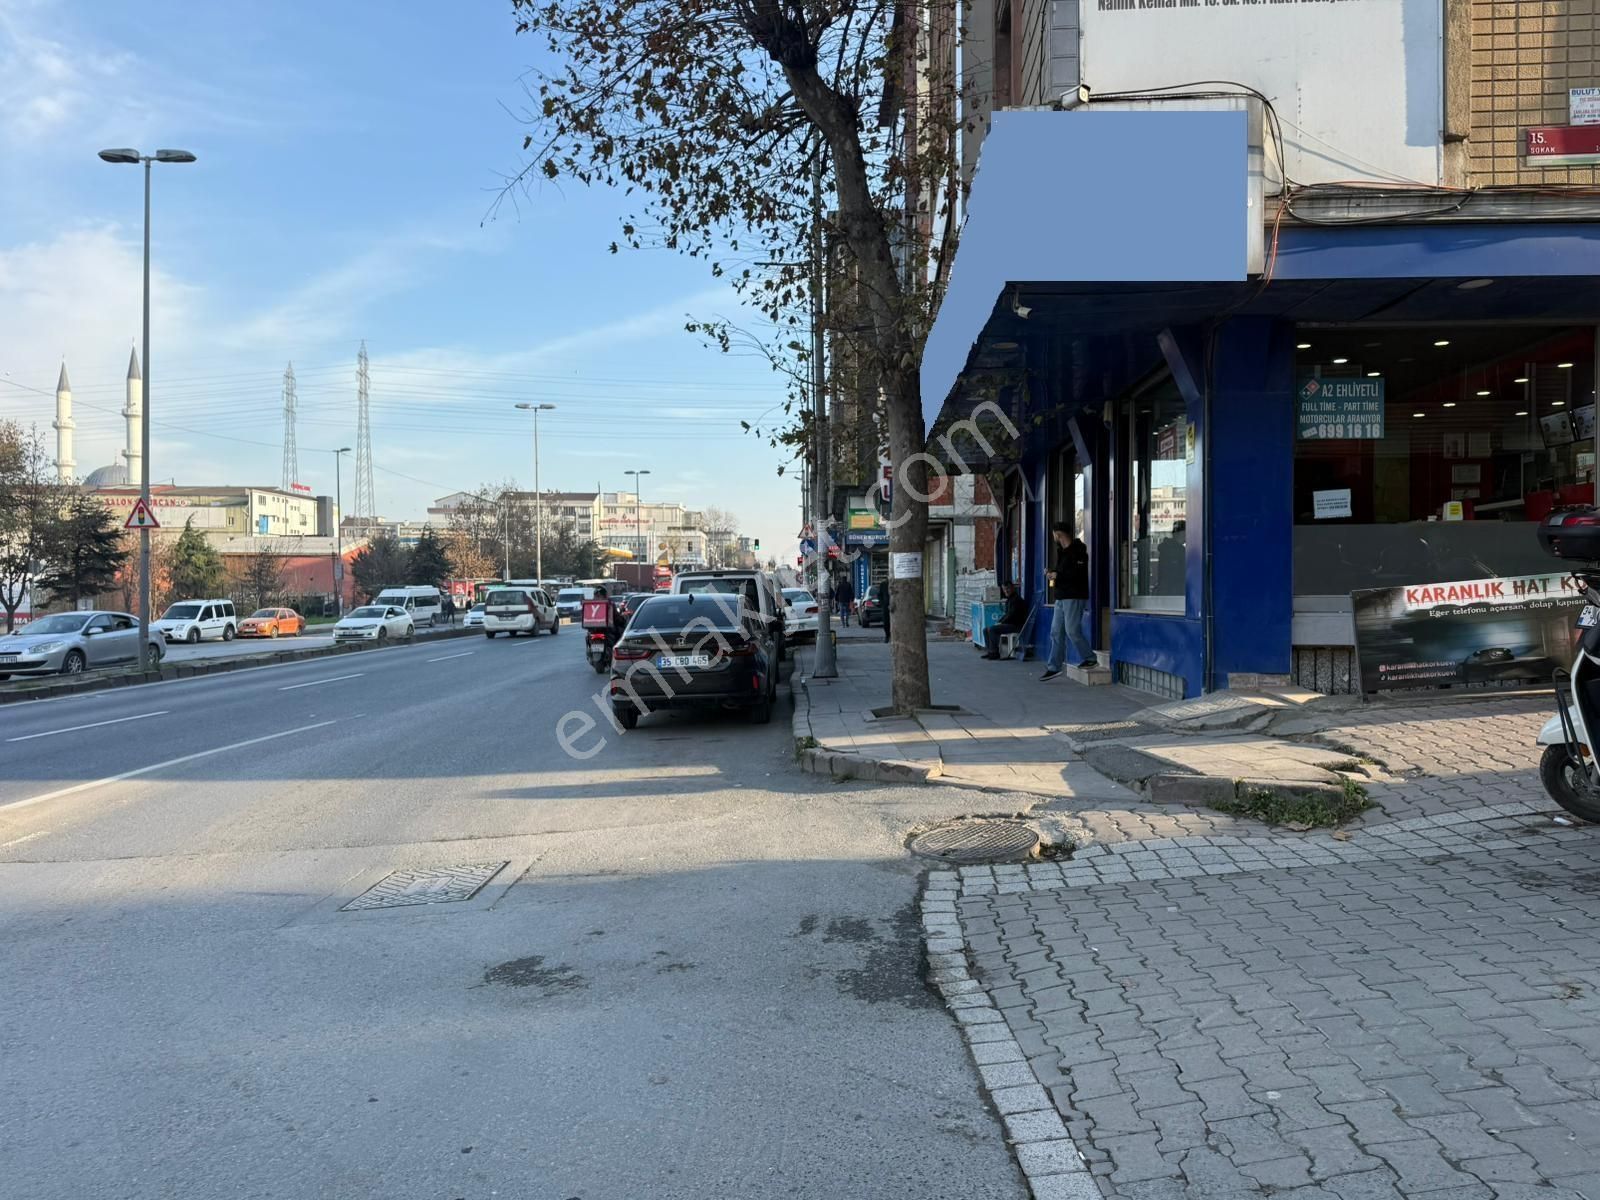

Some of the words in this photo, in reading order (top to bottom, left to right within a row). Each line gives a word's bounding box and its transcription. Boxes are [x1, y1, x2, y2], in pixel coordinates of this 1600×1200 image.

[1571, 88, 1595, 96] BULUT
[1530, 132, 1547, 144] 15.
[1530, 146, 1555, 154] SOKAK
[1322, 384, 1333, 397] A2
[1336, 382, 1378, 397] EHLİYETLİ
[1301, 402, 1318, 411] FULL
[1343, 402, 1361, 411] PART
[1299, 414, 1345, 424] MOTORCULAR
[1346, 414, 1381, 423] ARANIYOR
[1318, 424, 1344, 438] 699
[1346, 423, 1362, 438] 16
[1365, 423, 1380, 438] 16
[1406, 582, 1504, 603] KARANLIK
[1513, 577, 1550, 597] HAT
[1429, 609, 1450, 618] Eğer
[1453, 606, 1487, 616] telefonu
[1490, 603, 1527, 613] açarsan,
[1529, 601, 1553, 610] dolap
